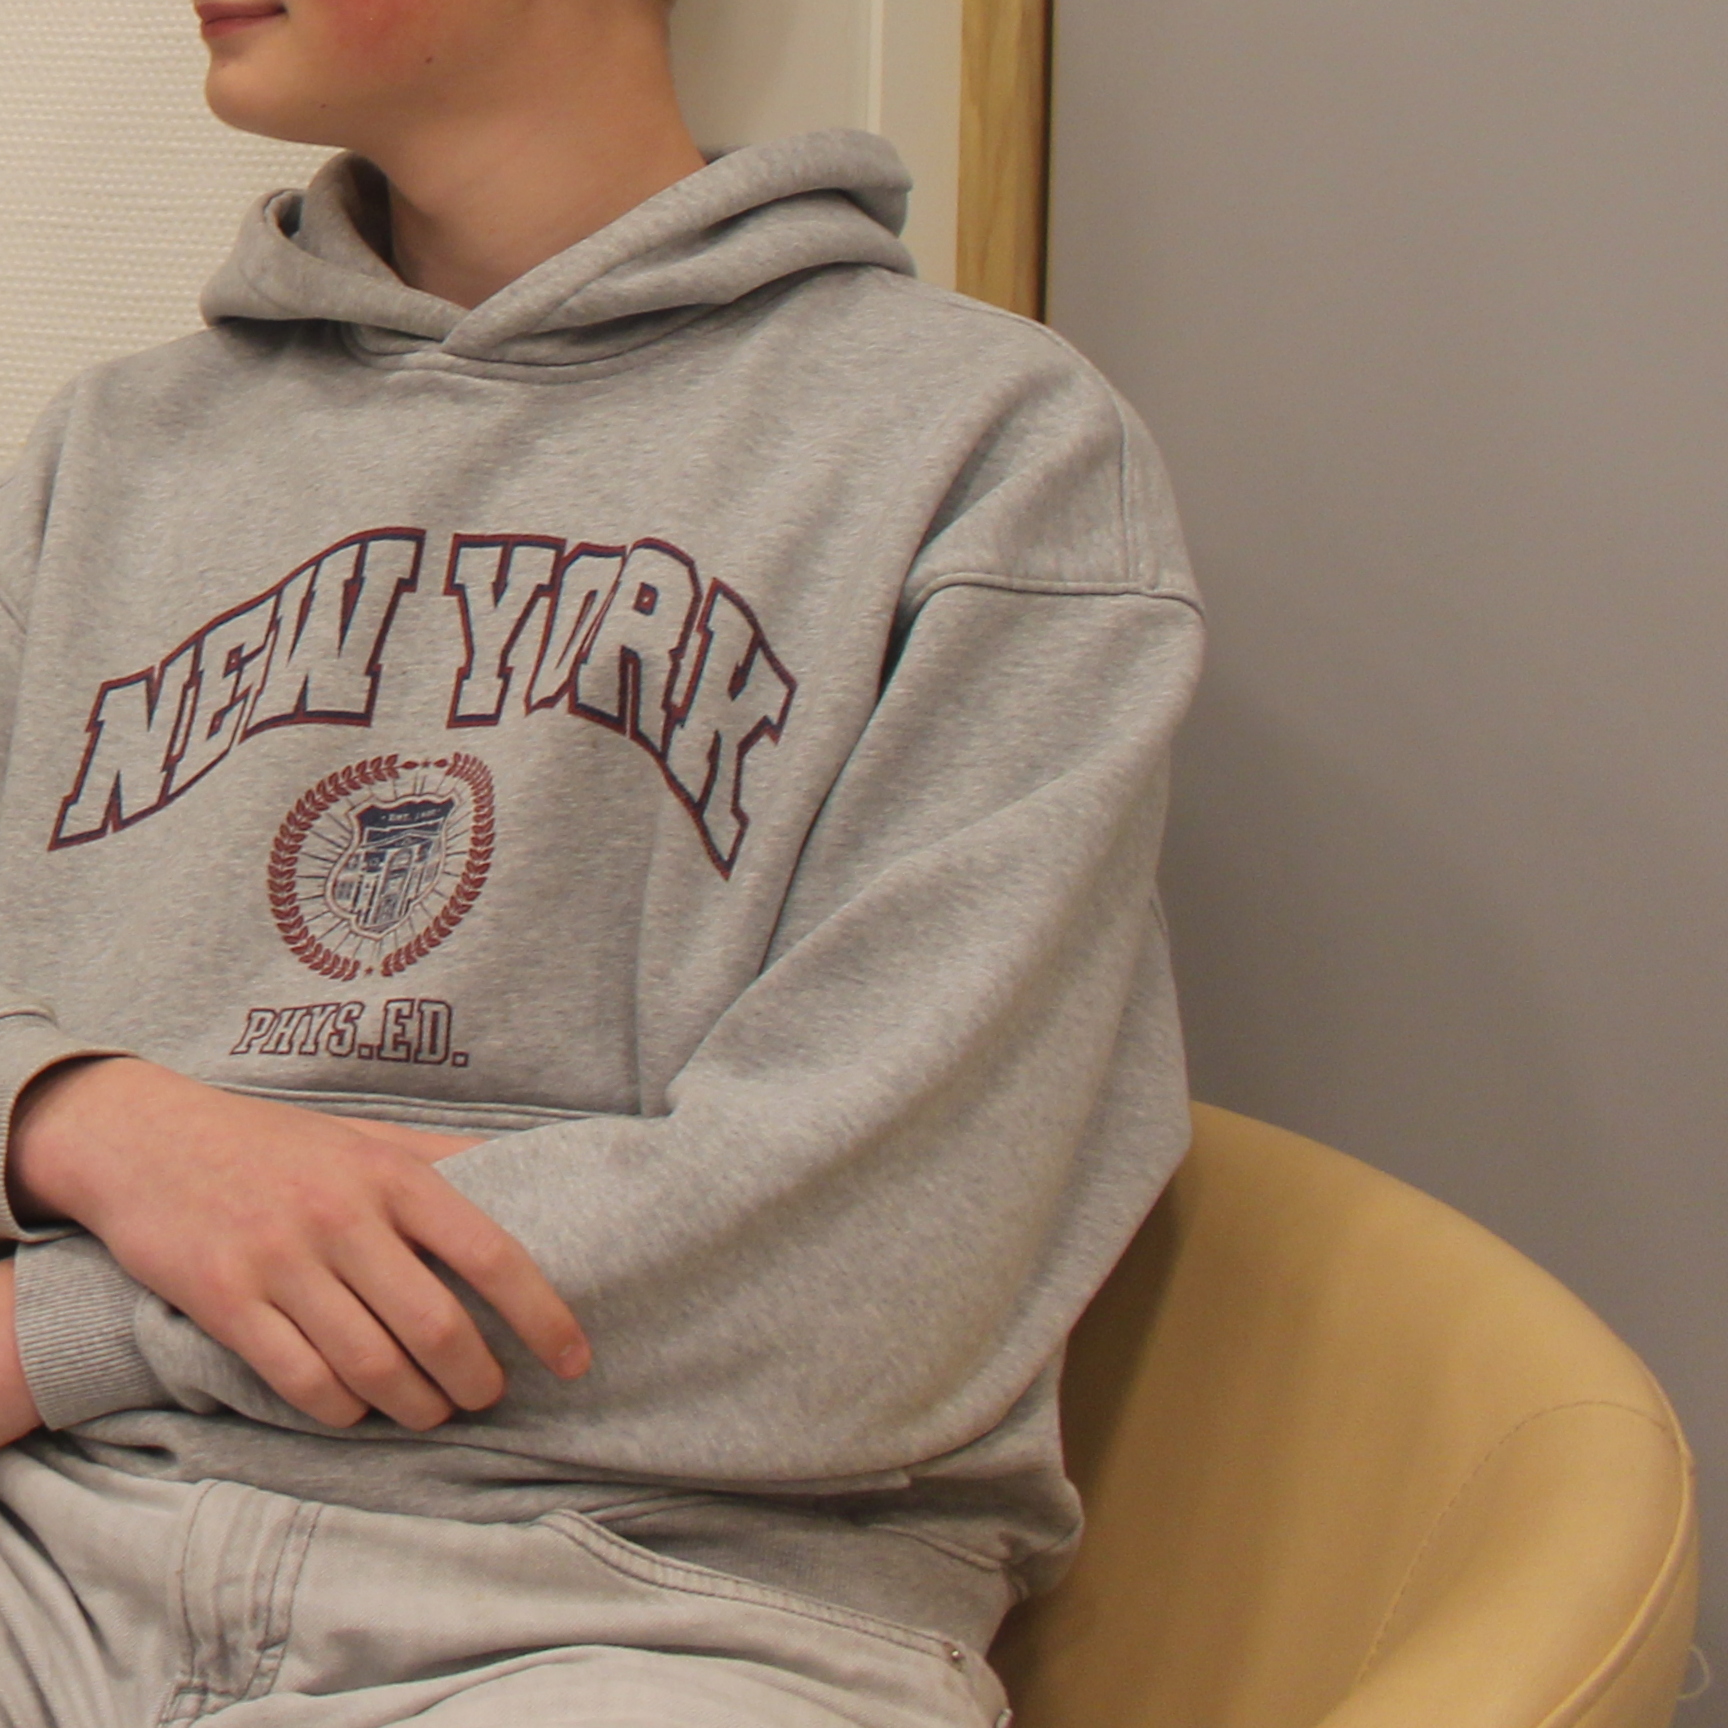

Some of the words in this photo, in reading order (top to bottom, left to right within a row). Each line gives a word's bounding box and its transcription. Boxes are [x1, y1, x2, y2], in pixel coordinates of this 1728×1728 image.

[47, 526, 426, 852] NEW
[443, 532, 798, 881] YORK
[229, 997, 471, 1068] PHYS.ED.
